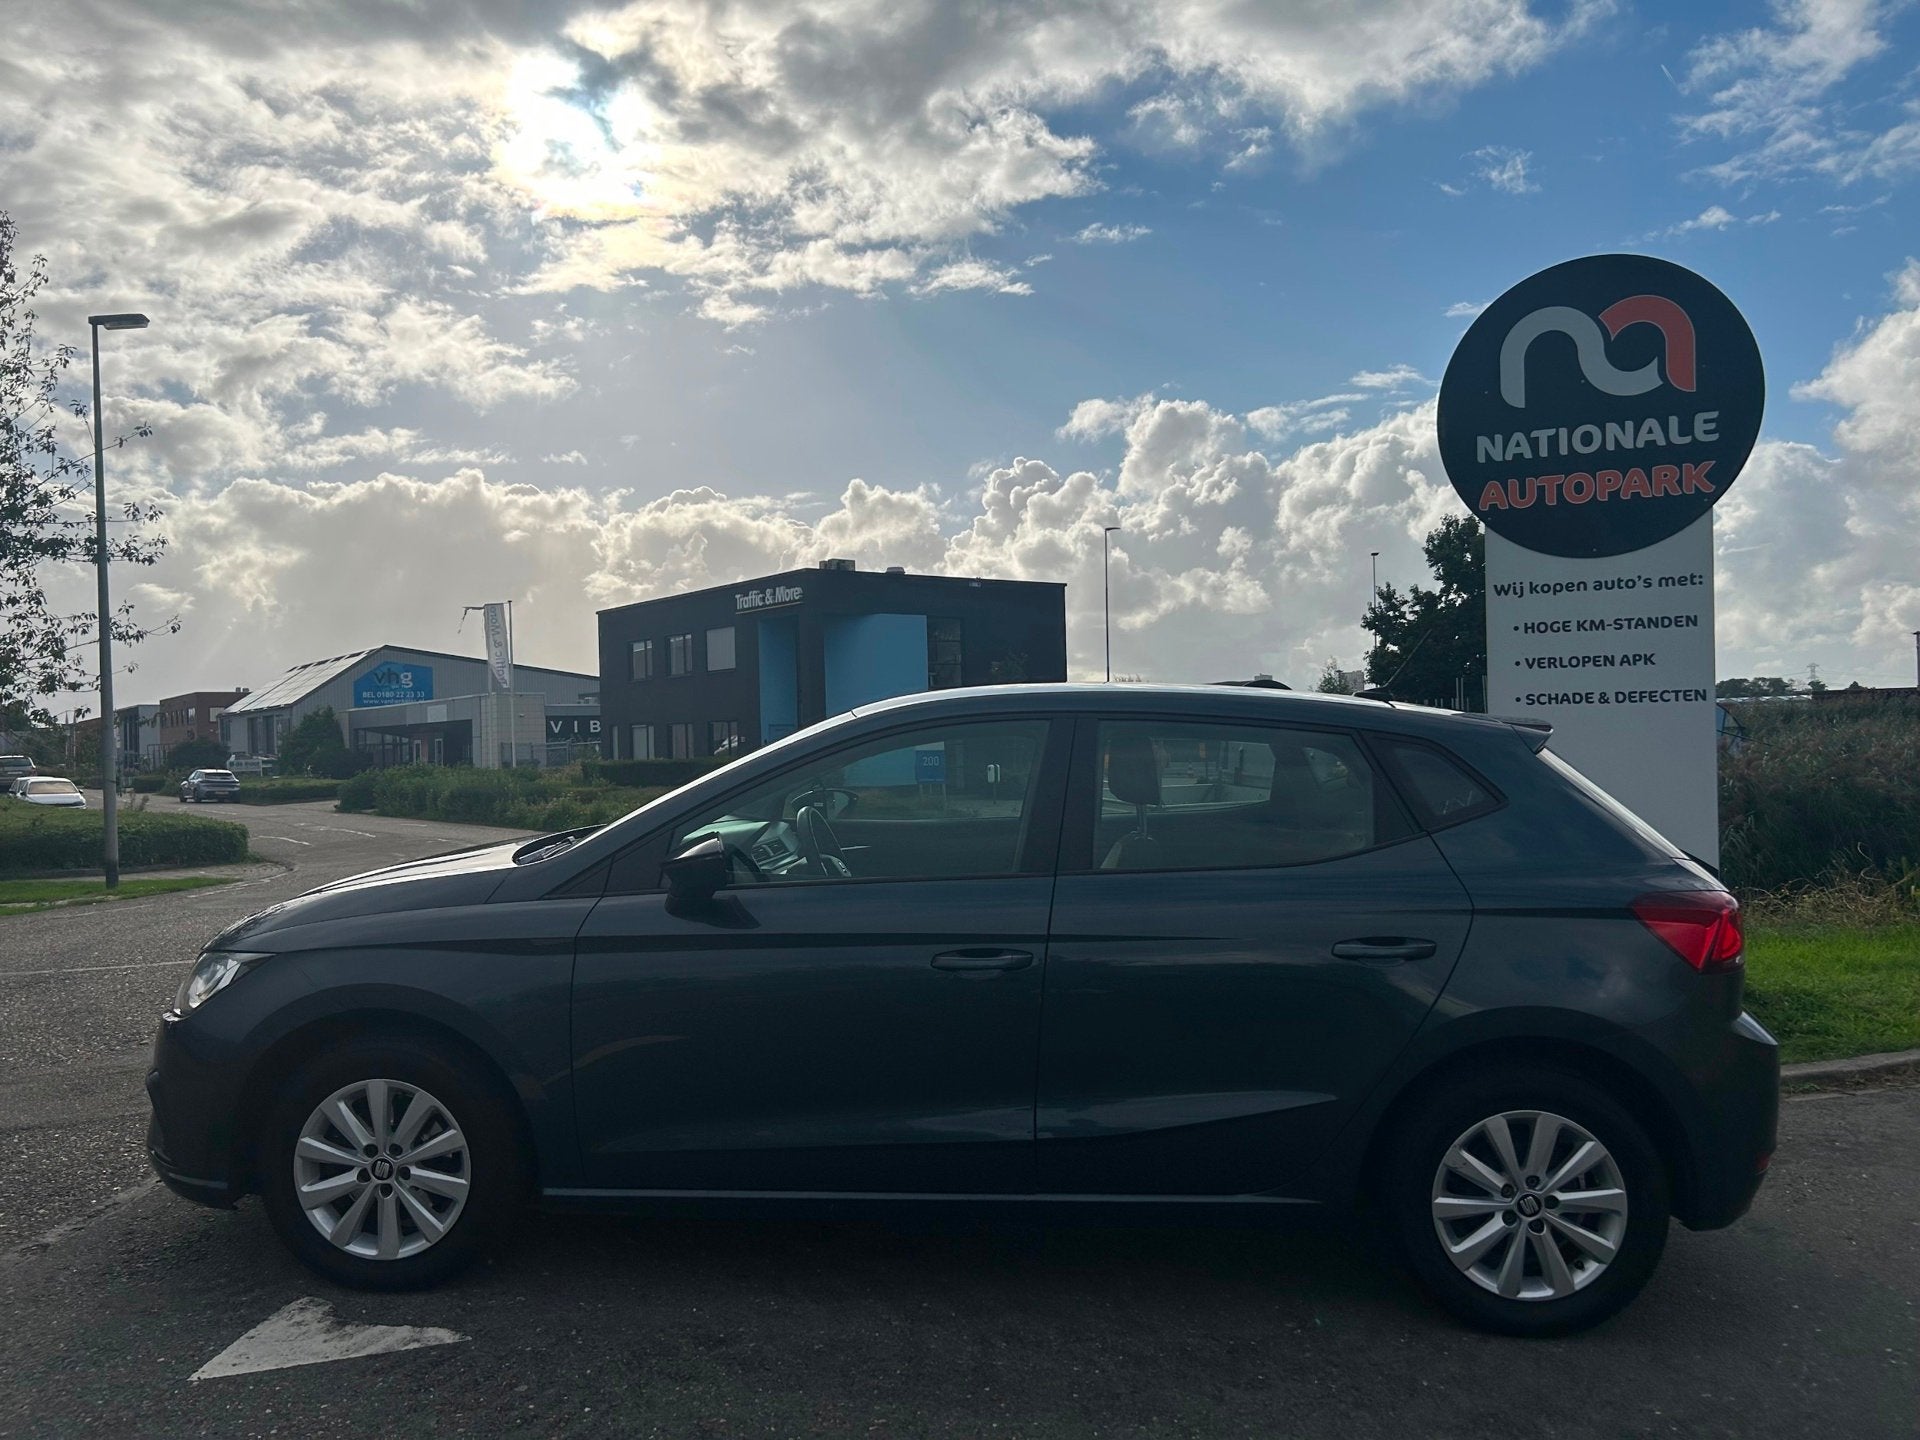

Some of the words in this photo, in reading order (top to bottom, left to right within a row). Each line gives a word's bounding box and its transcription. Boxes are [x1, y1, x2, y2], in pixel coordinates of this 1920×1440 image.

[1477, 411, 1719, 463] NATIONALE
[1479, 460, 1716, 511] AUTOPARK
[1493, 581, 1524, 598] Wij
[1529, 579, 1588, 596] kopen
[1593, 575, 1652, 591] auto's
[1658, 572, 1704, 588] met:
[735, 590, 764, 610] Traffic
[765, 588, 773, 605] &
[775, 586, 803, 603] More
[1524, 621, 1572, 634] HOGE
[1576, 614, 1698, 632] KM-STANDEN
[1525, 655, 1615, 669] VERLOPEN
[1619, 653, 1656, 667] APK
[374, 668, 413, 688] vhg
[1526, 692, 1594, 706] SCHADE
[1598, 692, 1610, 705] &
[1614, 689, 1707, 704] DEFECTEN
[550, 720, 601, 733] VIB
[922, 756, 940, 766] 200
